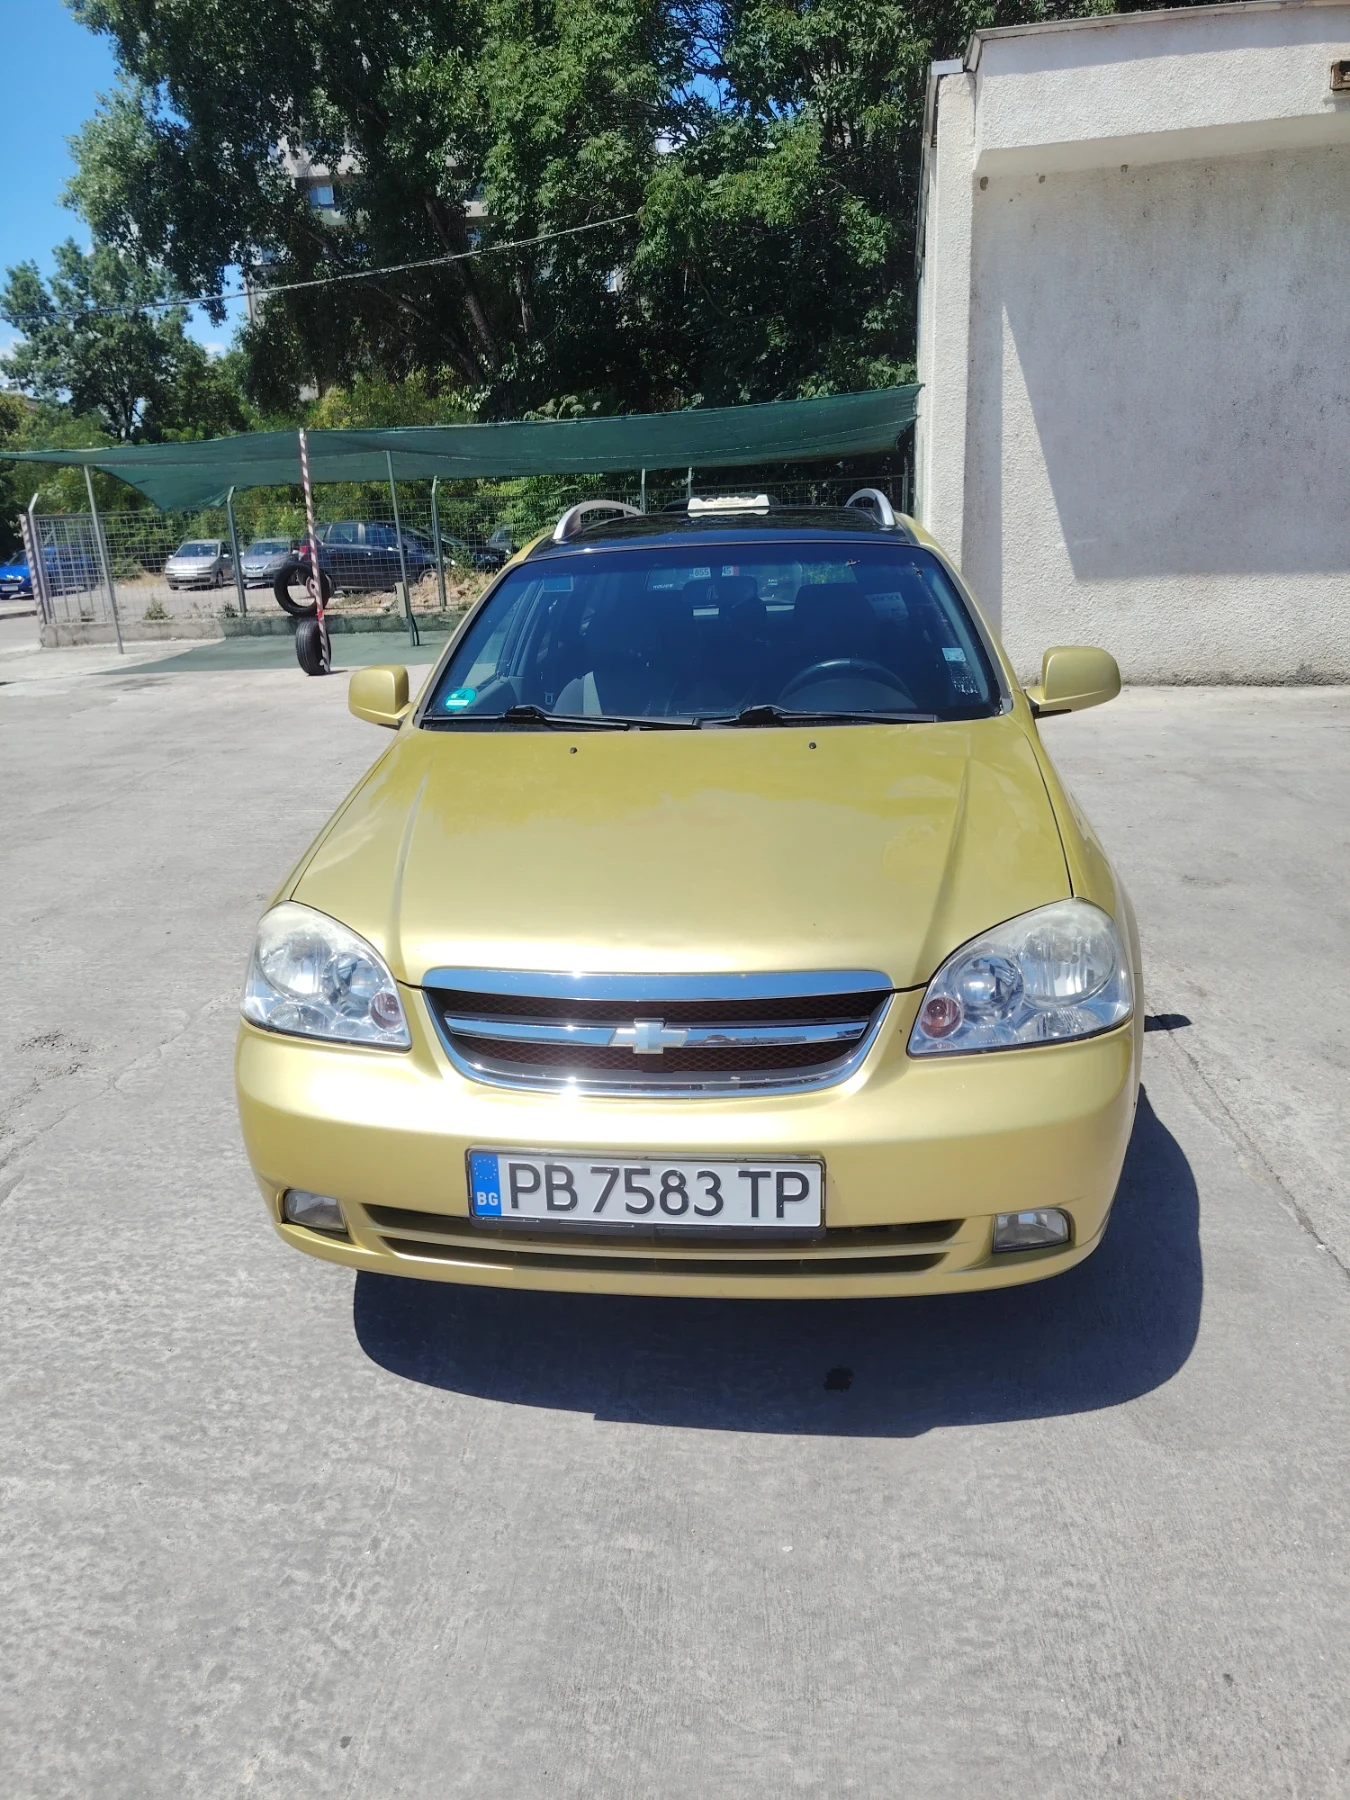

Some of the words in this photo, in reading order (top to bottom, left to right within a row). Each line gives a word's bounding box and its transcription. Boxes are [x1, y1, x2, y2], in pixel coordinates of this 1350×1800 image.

[476, 1191, 499, 1207] BG
[508, 1162, 578, 1211] PB
[589, 1166, 724, 1217] 7583
[738, 1170, 810, 1218] TP
